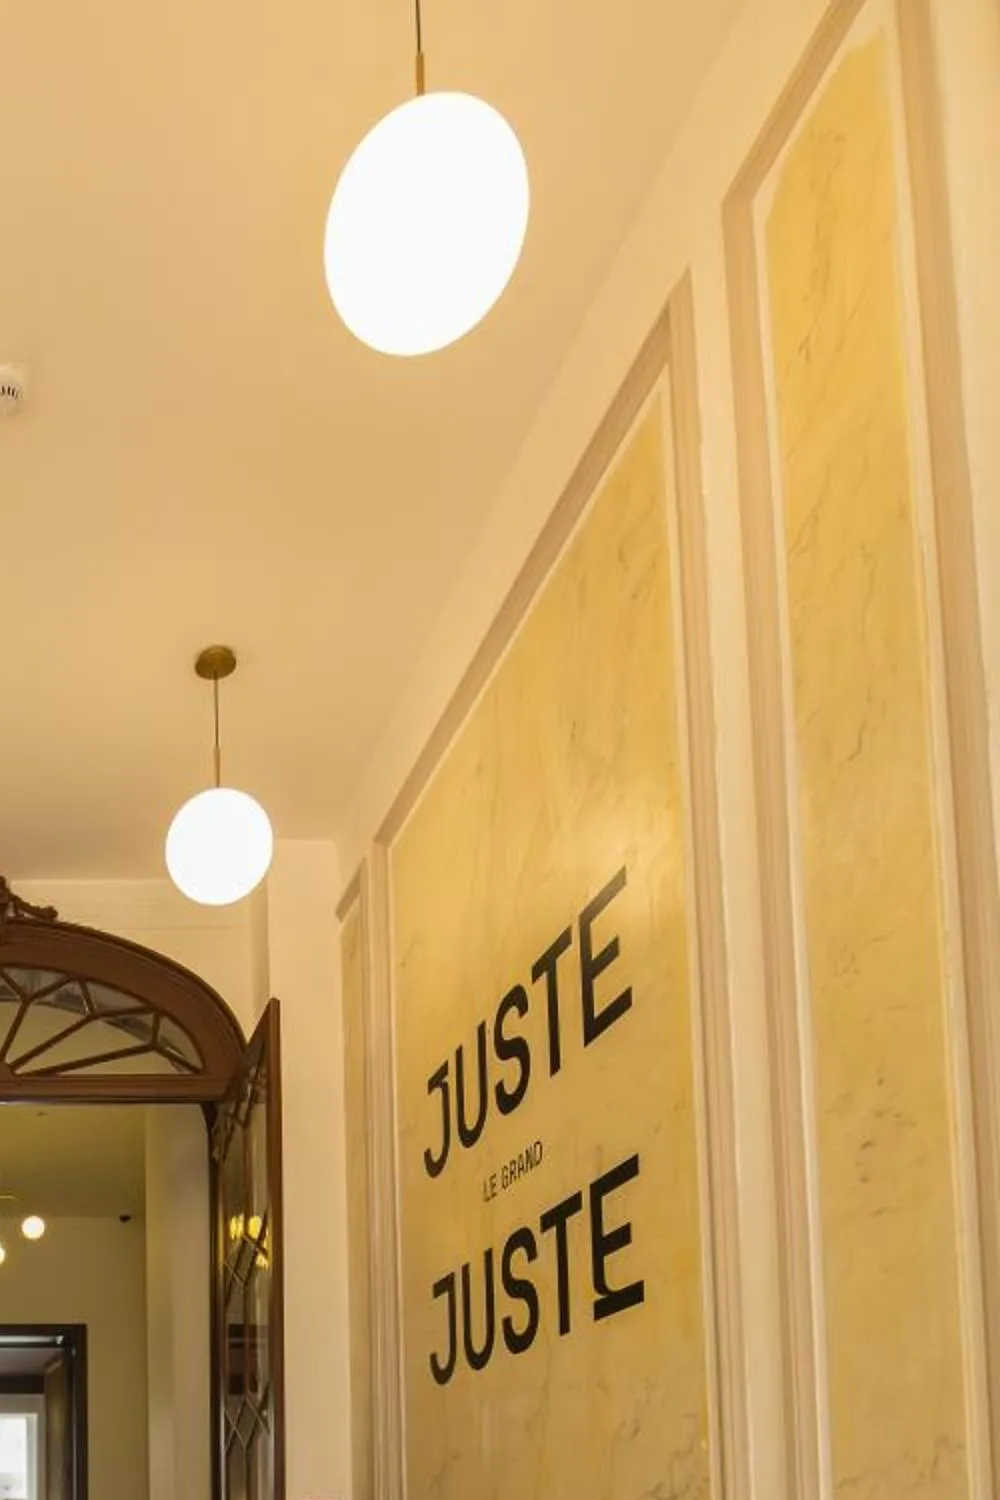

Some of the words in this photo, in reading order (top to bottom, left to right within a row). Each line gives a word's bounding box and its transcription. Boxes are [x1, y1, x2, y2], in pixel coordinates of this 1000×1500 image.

[424, 865, 632, 1178] JUSTE
[429, 1153, 644, 1386] JUSTE
[483, 1173, 497, 1202] LE
[502, 1141, 542, 1190] GRAND
